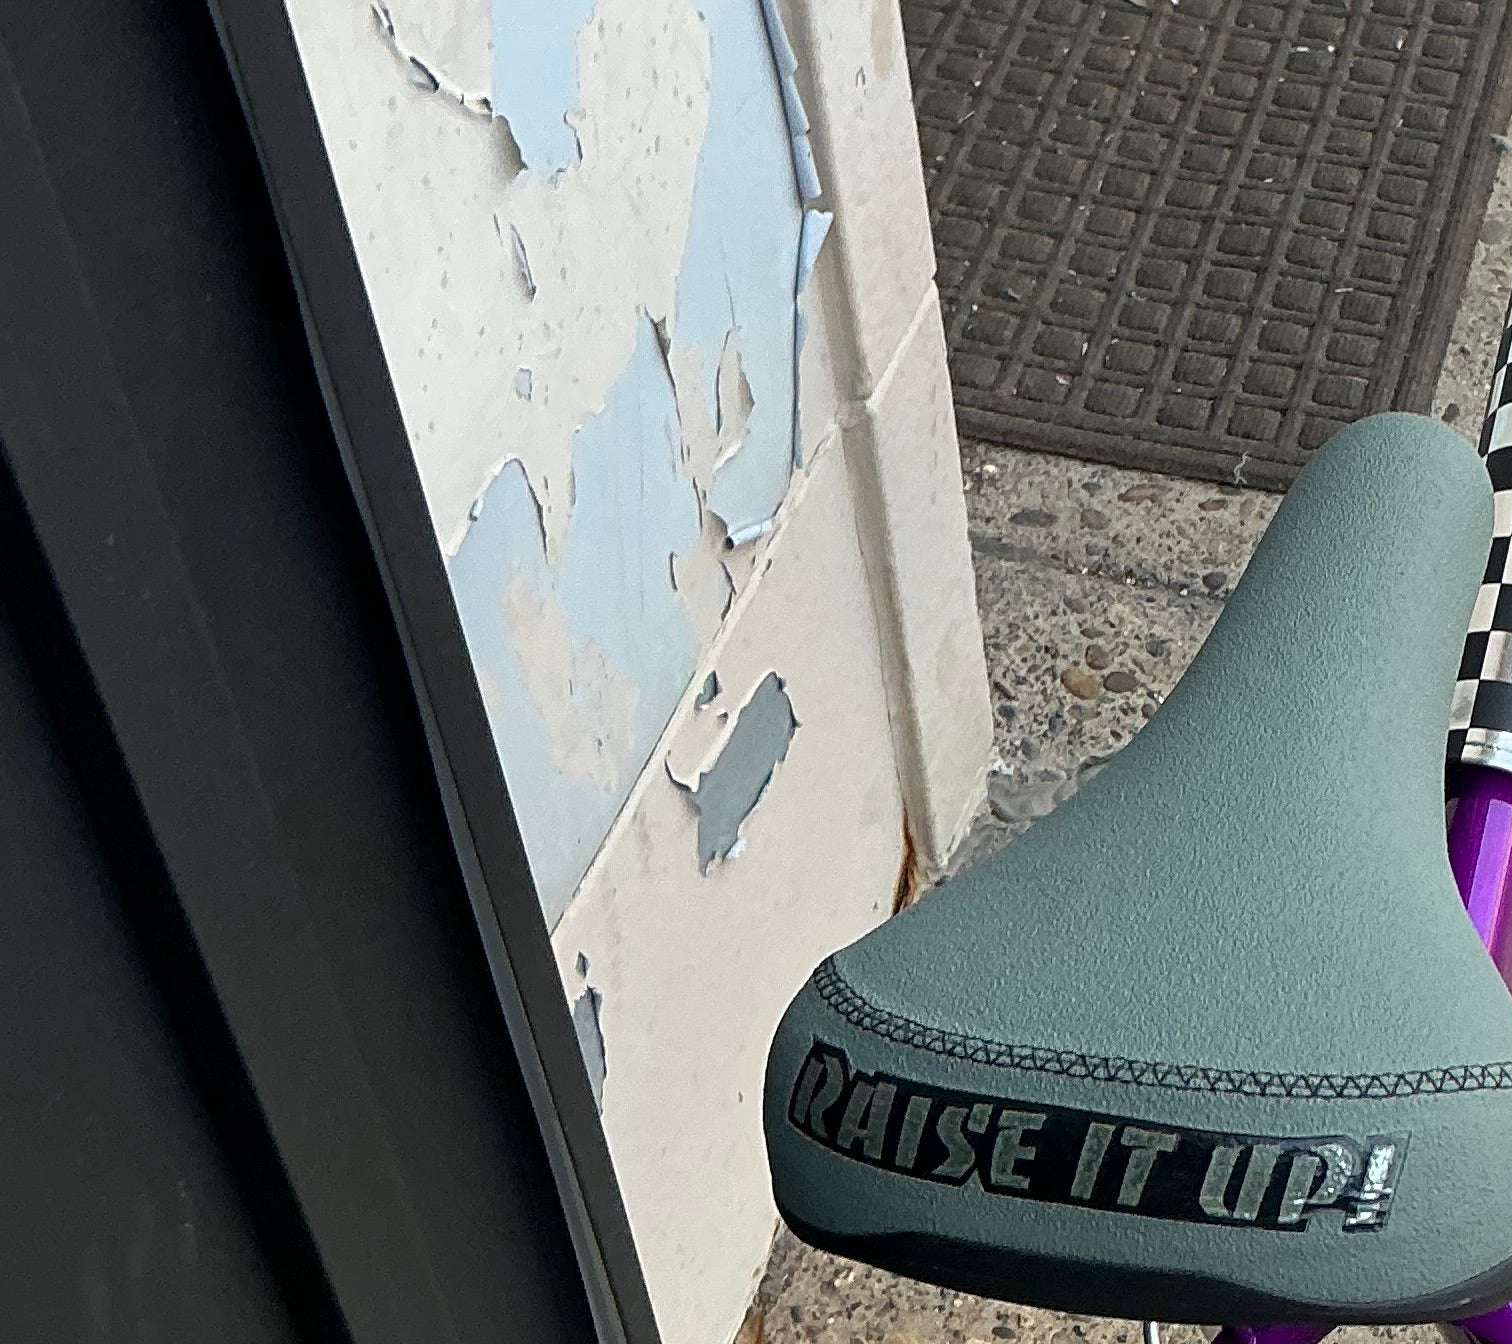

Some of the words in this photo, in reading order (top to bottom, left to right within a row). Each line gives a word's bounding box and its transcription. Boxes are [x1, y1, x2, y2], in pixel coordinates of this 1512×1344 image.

[792, 1050, 1048, 1191] RAISE
[1069, 1120, 1181, 1207] IT
[1199, 1141, 1396, 1226] UP!
